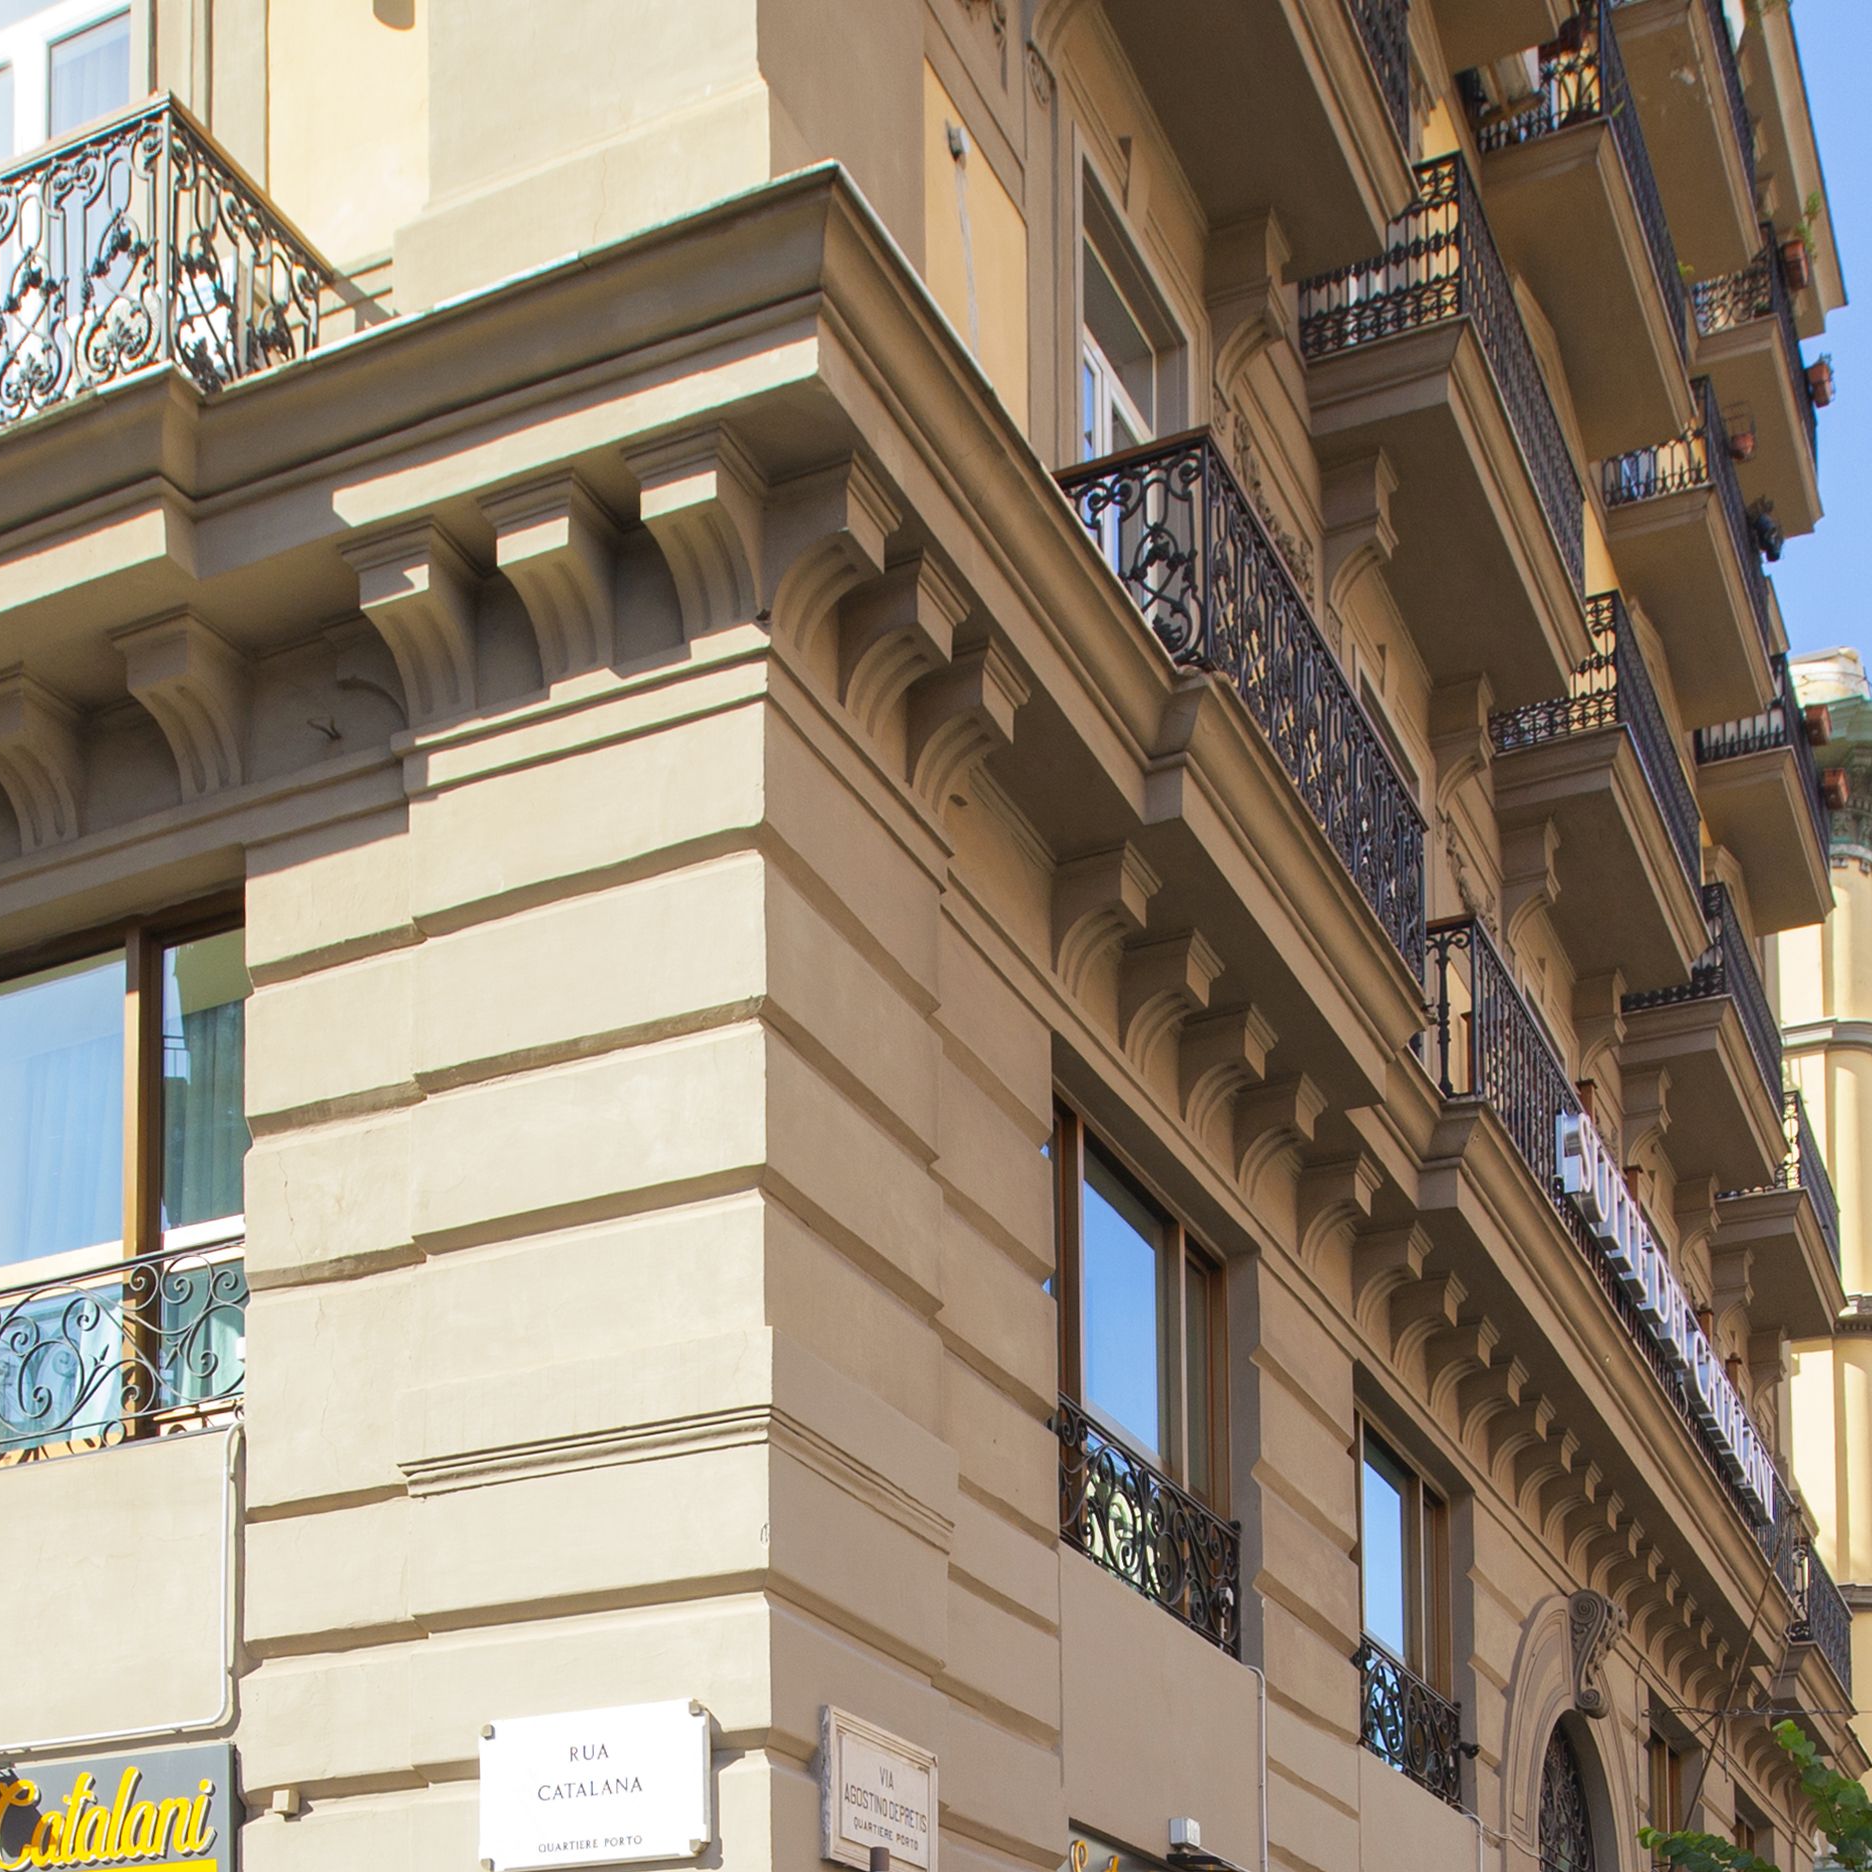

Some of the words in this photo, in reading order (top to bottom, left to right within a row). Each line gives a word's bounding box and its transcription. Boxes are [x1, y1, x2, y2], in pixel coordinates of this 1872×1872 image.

[1560, 1112, 1648, 1303] SUITE
[569, 1743, 609, 1762] RUA
[537, 1776, 643, 1801] CATALANA
[879, 1766, 894, 1790] VIA
[844, 1783, 888, 1817] AGOSTINO
[888, 1801, 927, 1833] DEPRETIS
[538, 1838, 599, 1853] QUARTIERE
[604, 1834, 643, 1848] PORTO
[853, 1816, 893, 1841] QUARTIERE
[895, 1833, 919, 1850] PORTO
